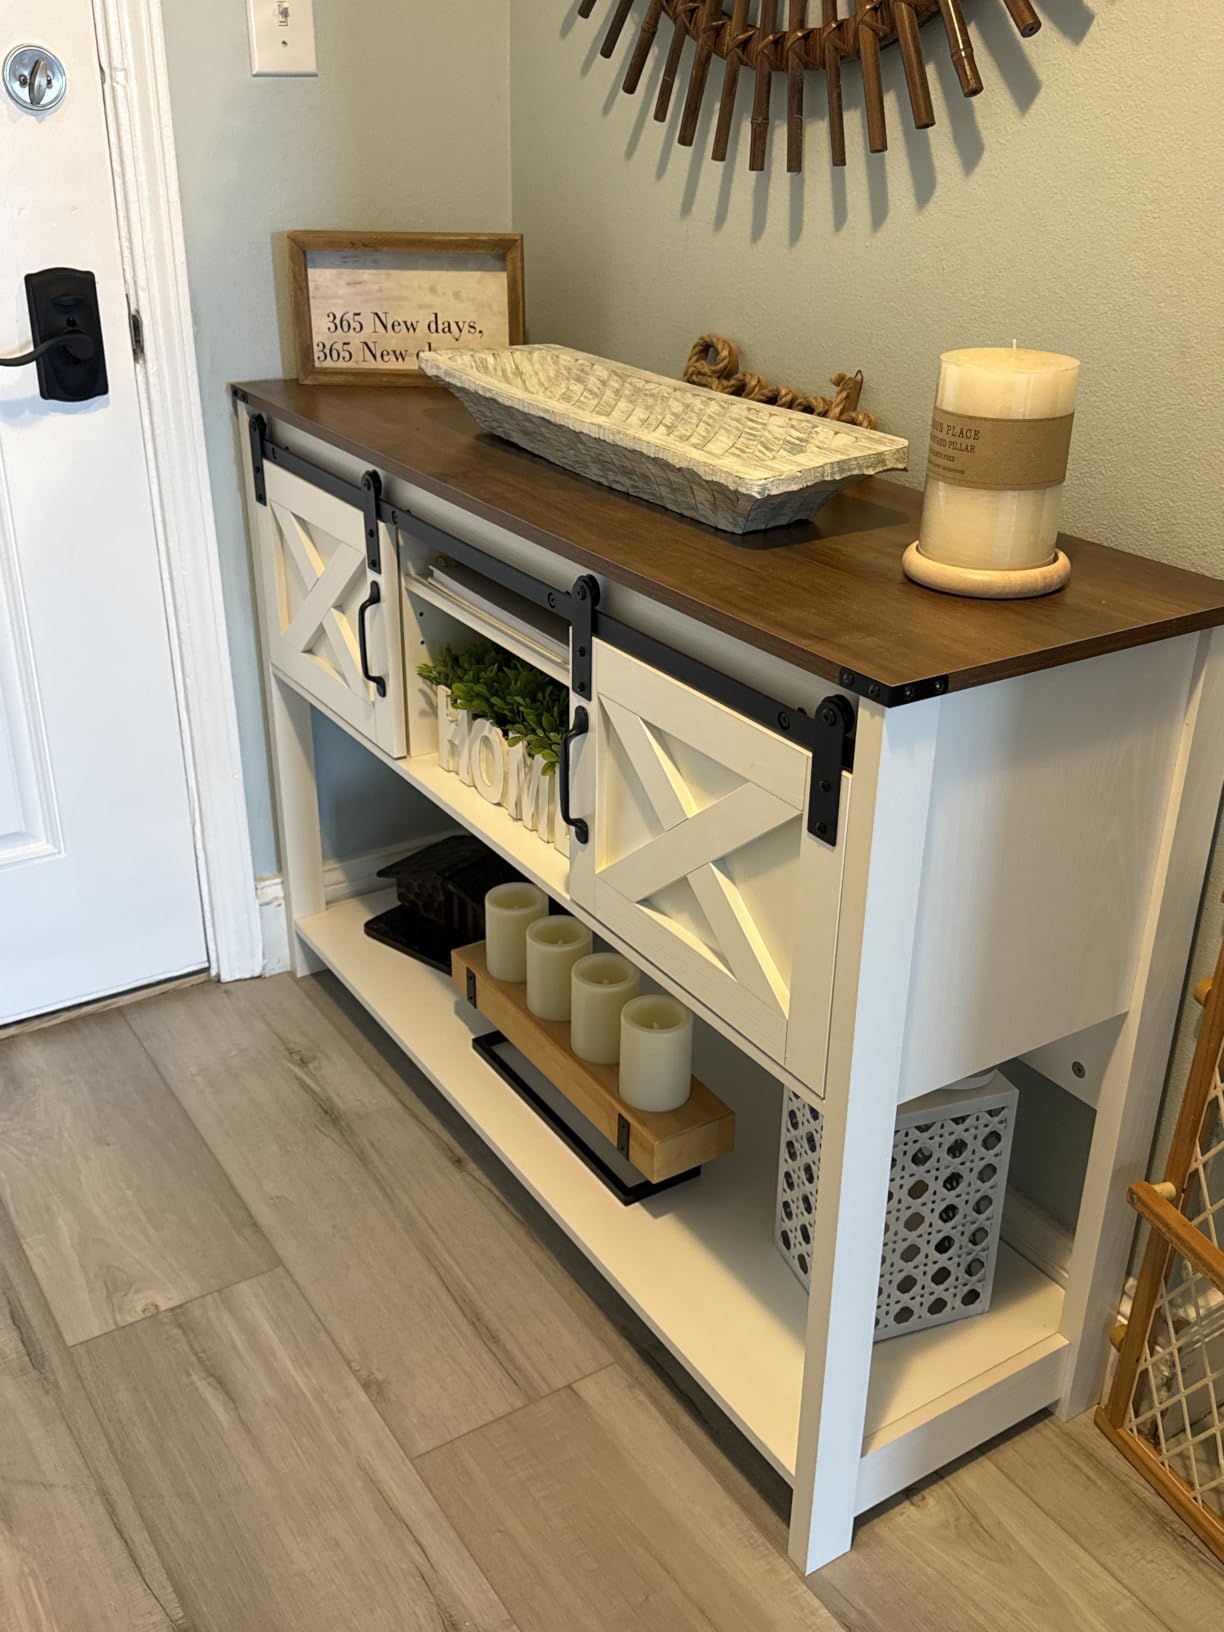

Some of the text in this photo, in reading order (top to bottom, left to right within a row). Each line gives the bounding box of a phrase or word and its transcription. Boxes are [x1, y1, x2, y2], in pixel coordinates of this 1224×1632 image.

[327, 311, 485, 342] 365 New days,
[316, 340, 353, 363] 365
[360, 341, 408, 363] New
[946, 424, 981, 441] PLACE
[948, 440, 976, 454] PILLAR
[437, 684, 570, 860] HOM
